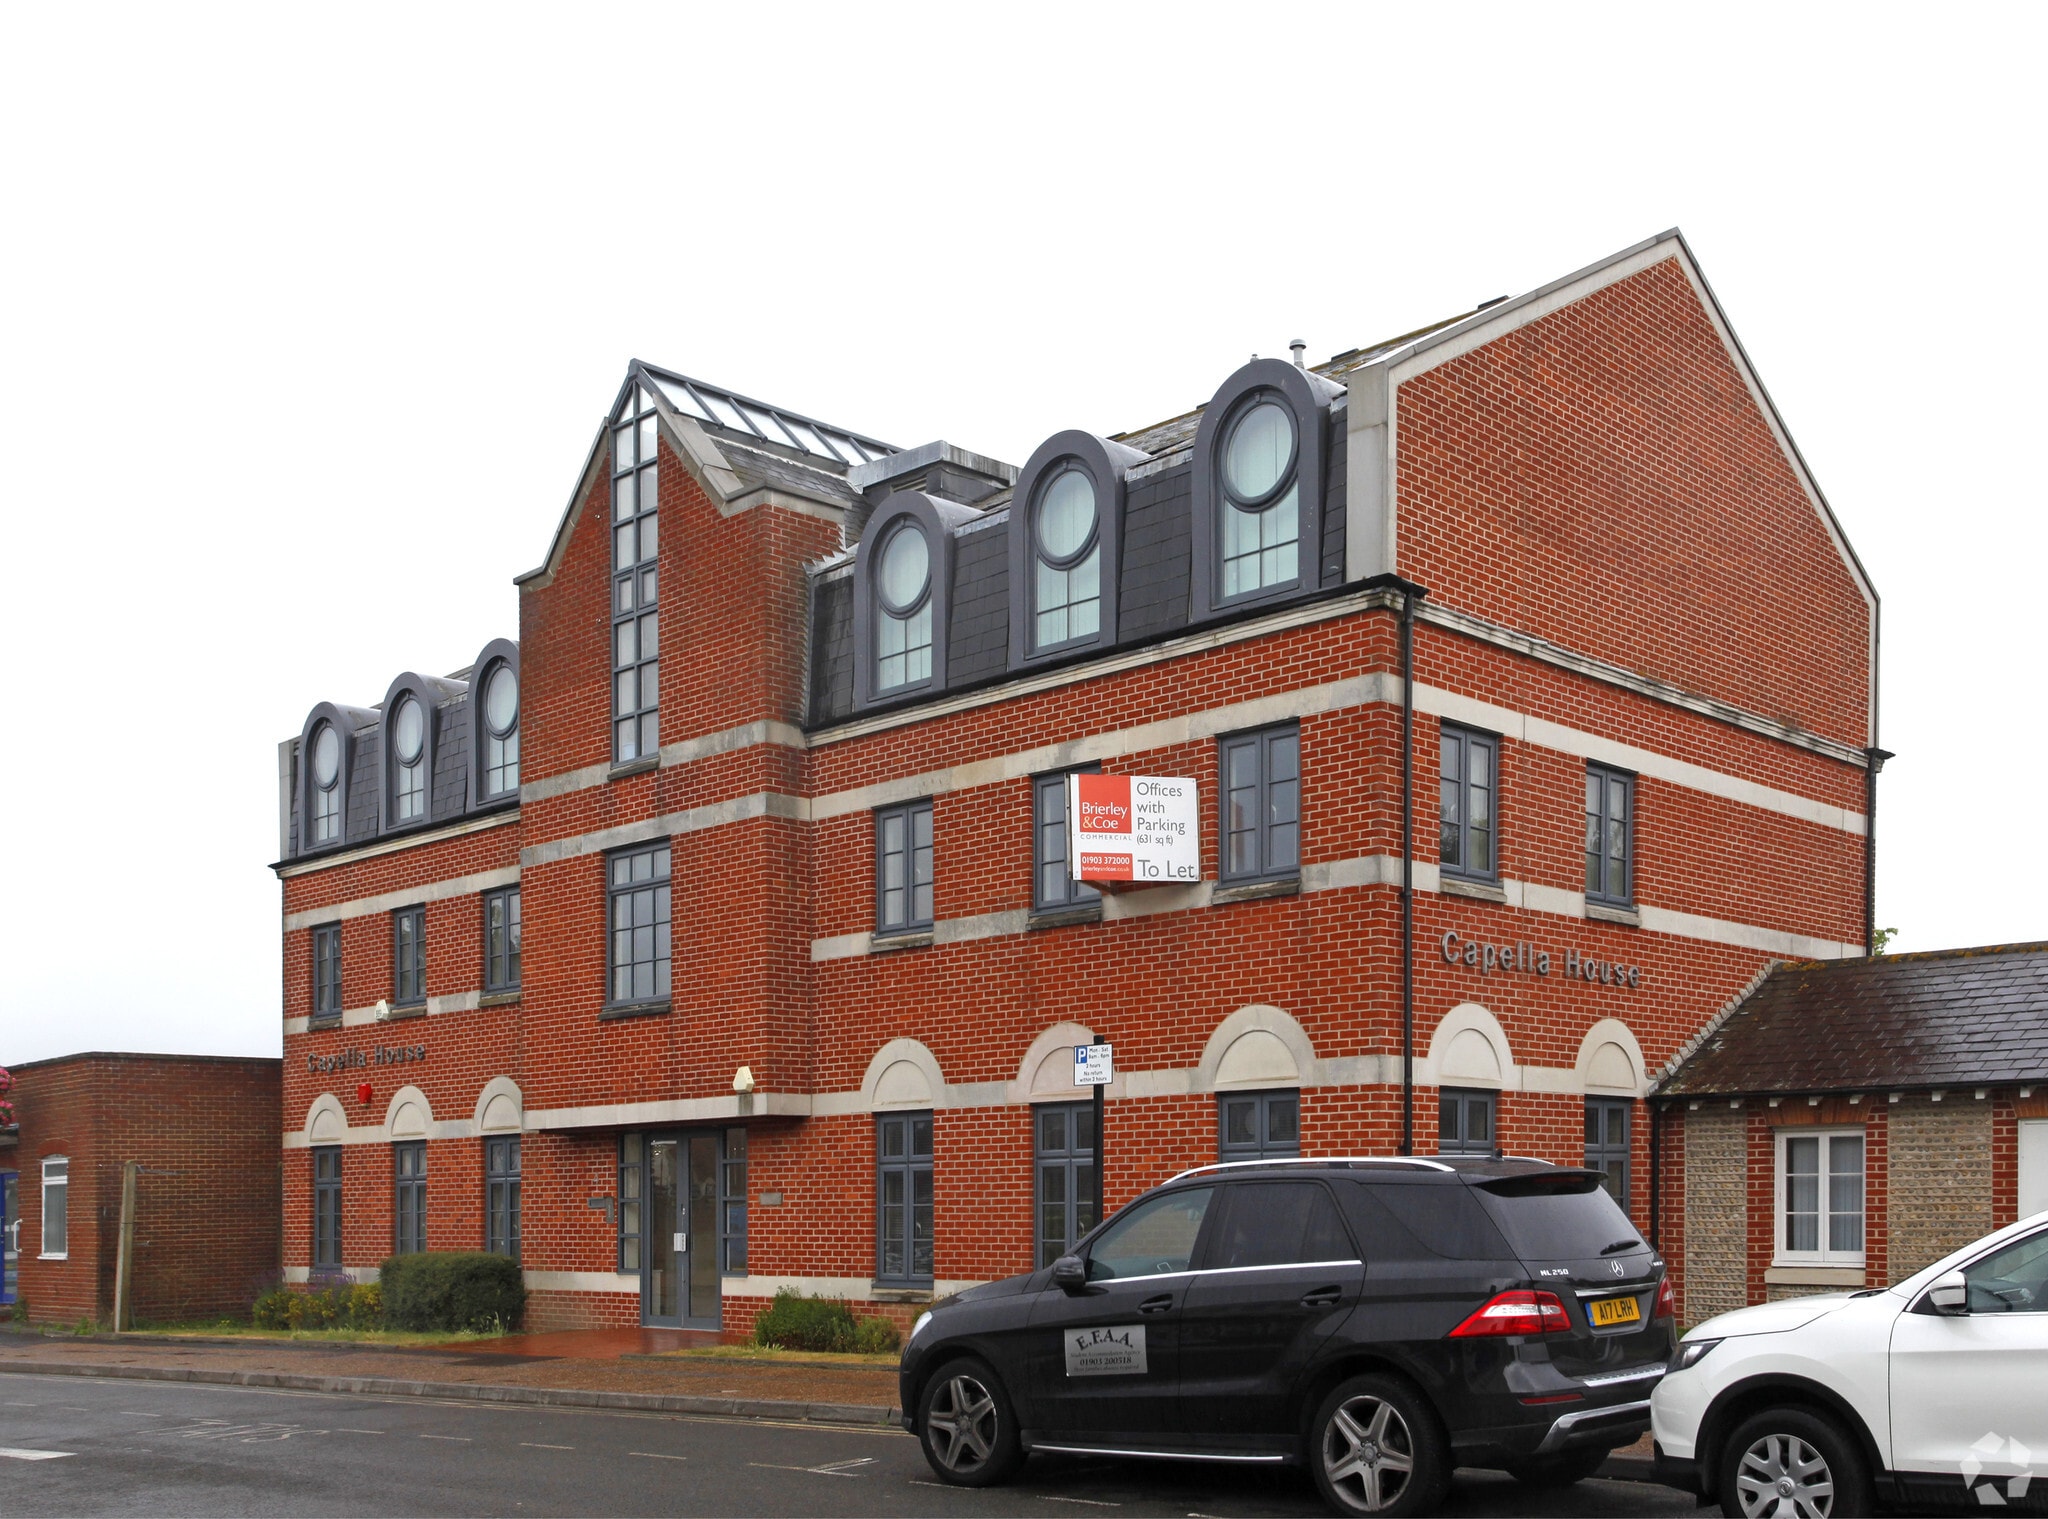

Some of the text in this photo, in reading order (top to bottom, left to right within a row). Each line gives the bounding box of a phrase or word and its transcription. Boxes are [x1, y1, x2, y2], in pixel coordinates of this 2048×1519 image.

[1136, 782, 1183, 797] Offices
[1082, 801, 1128, 819] Brierley
[1136, 800, 1165, 814] with
[1137, 817, 1186, 836] Parking
[1080, 833, 1132, 841] COMMERCIAL
[1136, 834, 1152, 846] (631
[1155, 836, 1164, 846] sq
[1082, 856, 1130, 865] 01903 372000
[1137, 859, 1195, 878] To Let
[1442, 931, 1640, 987] Capella House
[307, 1043, 425, 1075] Capella House
[1078, 1048, 1086, 1063] P
[1552, 1268, 1569, 1276] 250
[1613, 1299, 1634, 1318] LRH
